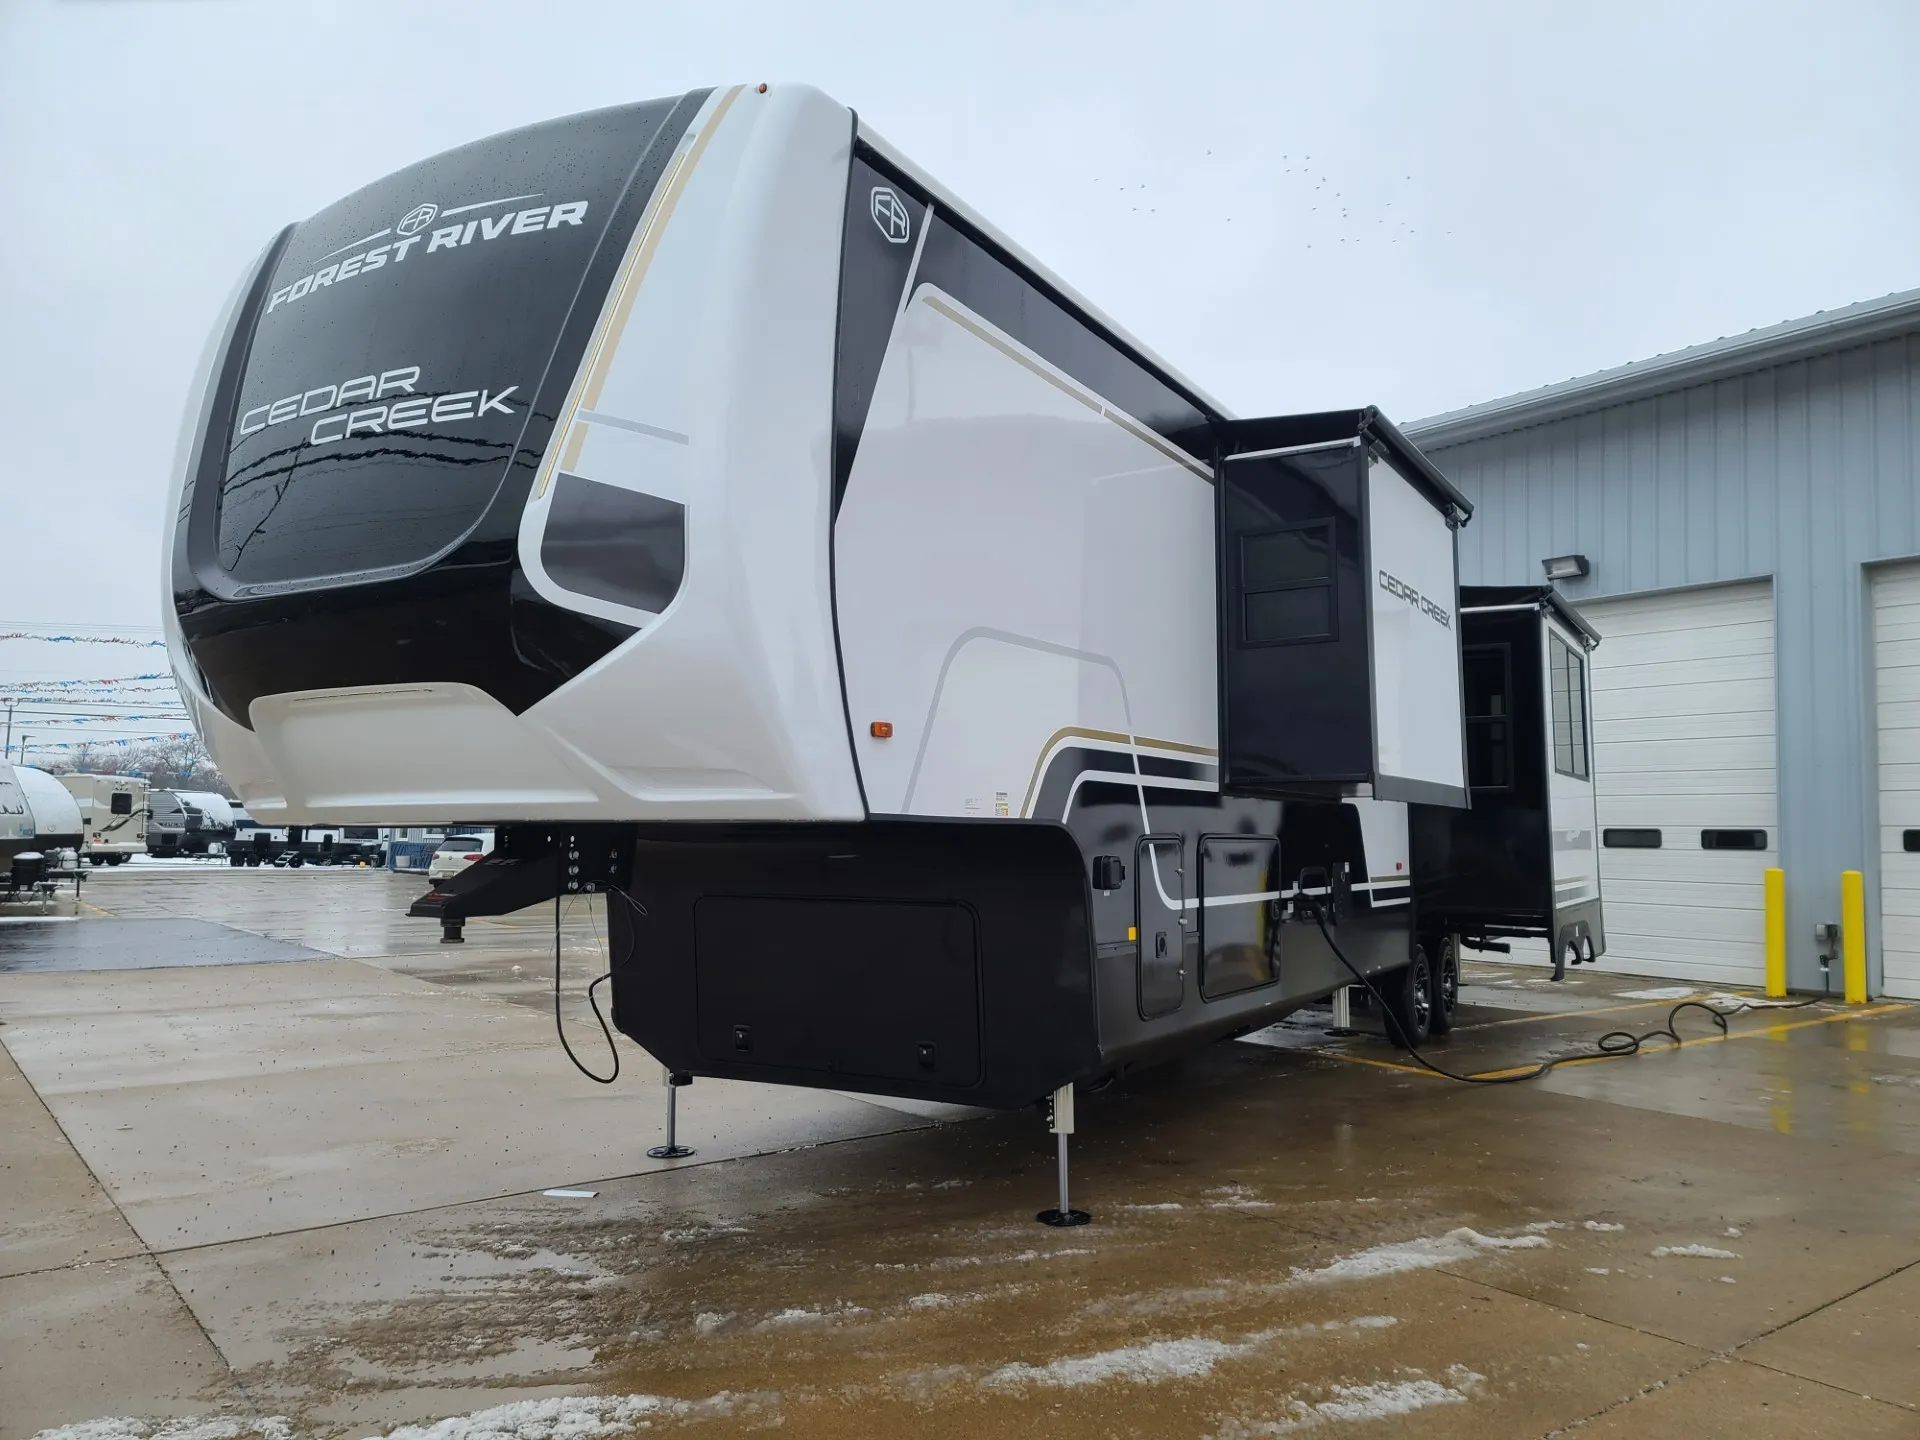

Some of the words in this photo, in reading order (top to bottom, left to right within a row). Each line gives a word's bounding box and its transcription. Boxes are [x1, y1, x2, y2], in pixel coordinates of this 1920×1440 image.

[266, 235, 421, 314] FOREST
[427, 201, 588, 253] RIVER
[240, 366, 420, 435] CEDAR
[310, 386, 519, 445] CREEK
[1379, 569, 1420, 610] CEDAR
[1421, 595, 1451, 631] CREEK
